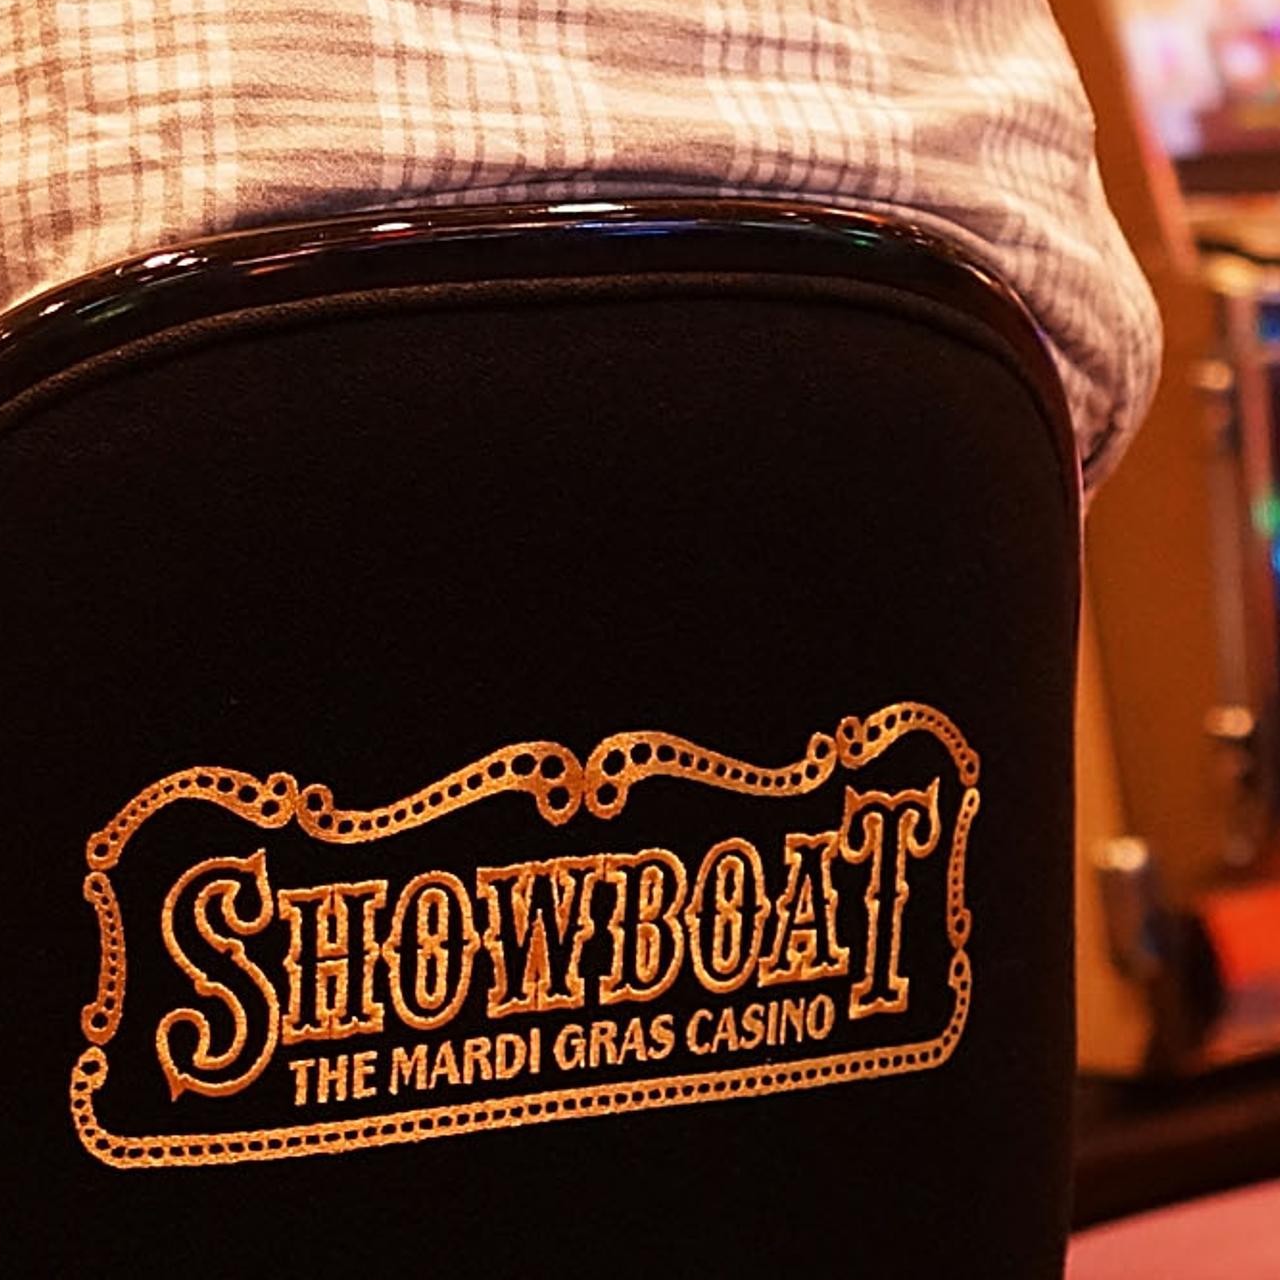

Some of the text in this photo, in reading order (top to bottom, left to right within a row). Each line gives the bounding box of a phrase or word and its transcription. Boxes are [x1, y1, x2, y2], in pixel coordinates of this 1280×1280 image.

[155, 777, 942, 1103] SHOWBOAT
[289, 994, 836, 1107] THE MARDI GRAS CASINO
